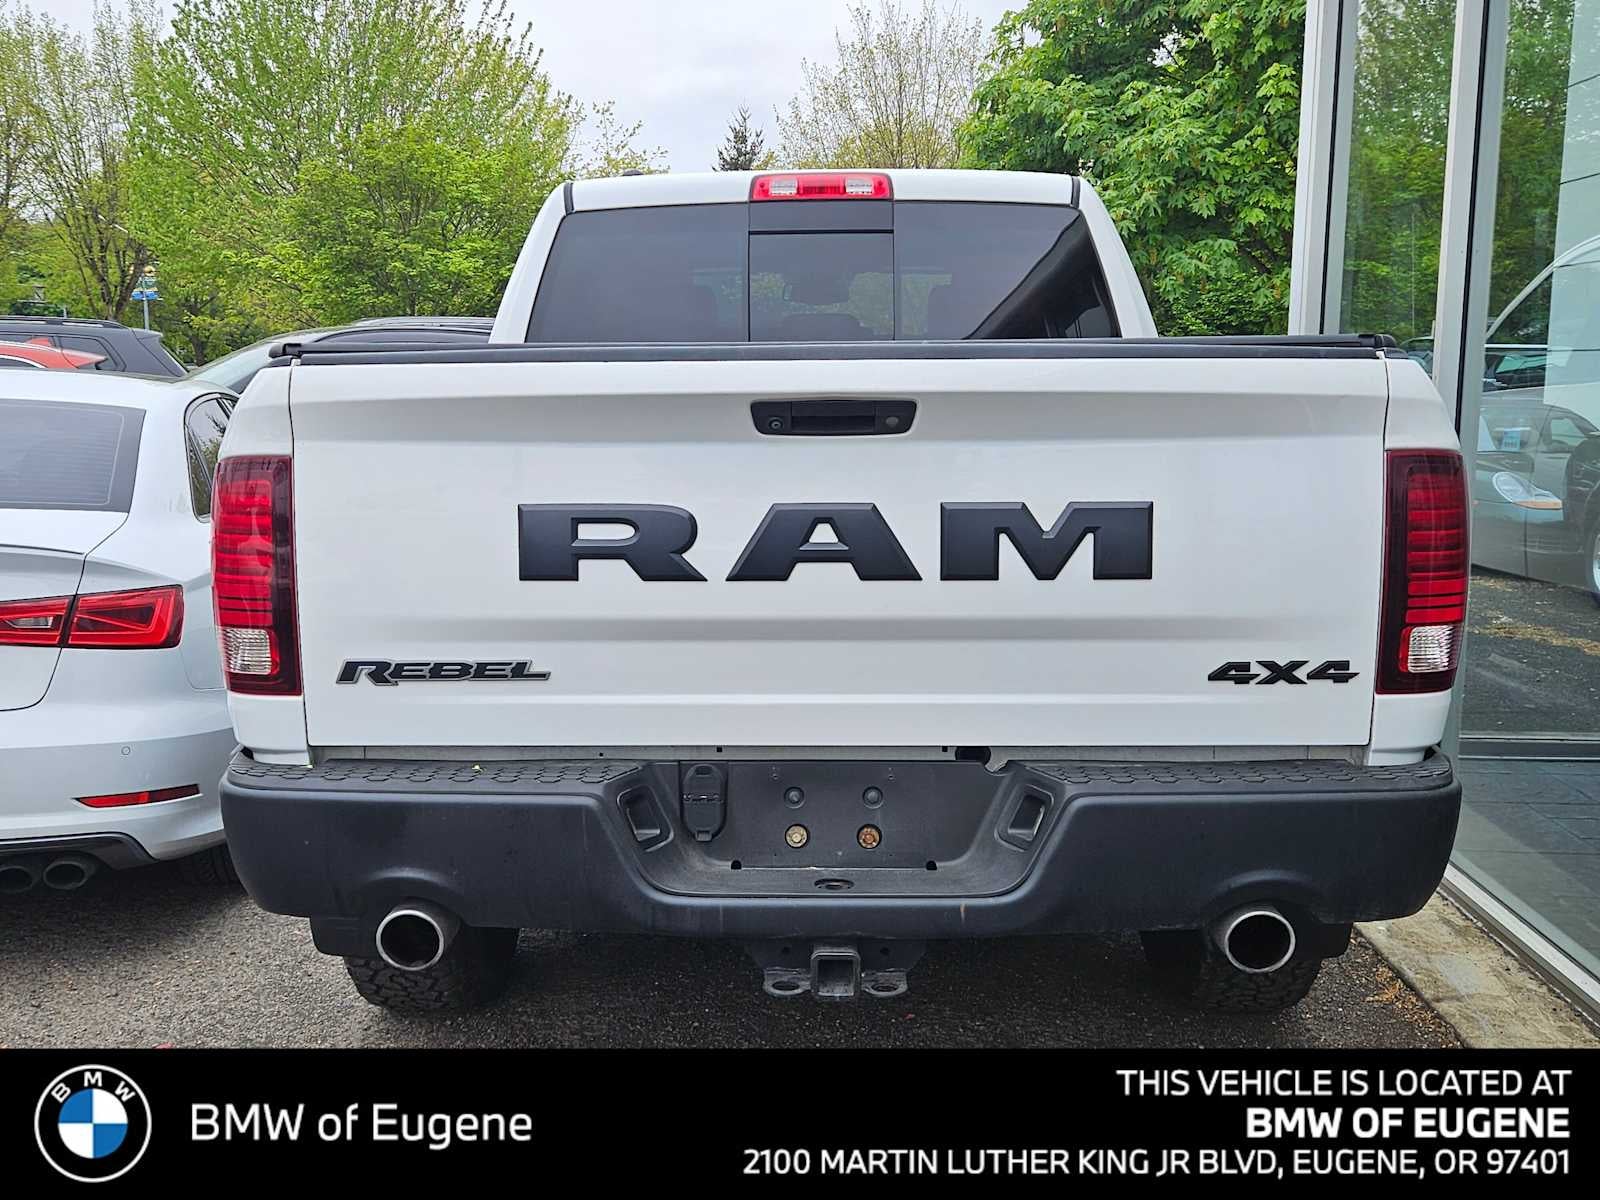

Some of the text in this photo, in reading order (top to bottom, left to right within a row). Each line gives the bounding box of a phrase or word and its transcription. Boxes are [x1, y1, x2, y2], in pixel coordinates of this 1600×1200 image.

[517, 500, 1154, 583] RAM
[336, 659, 551, 687] REBEL
[1207, 659, 1360, 686] 4X4
